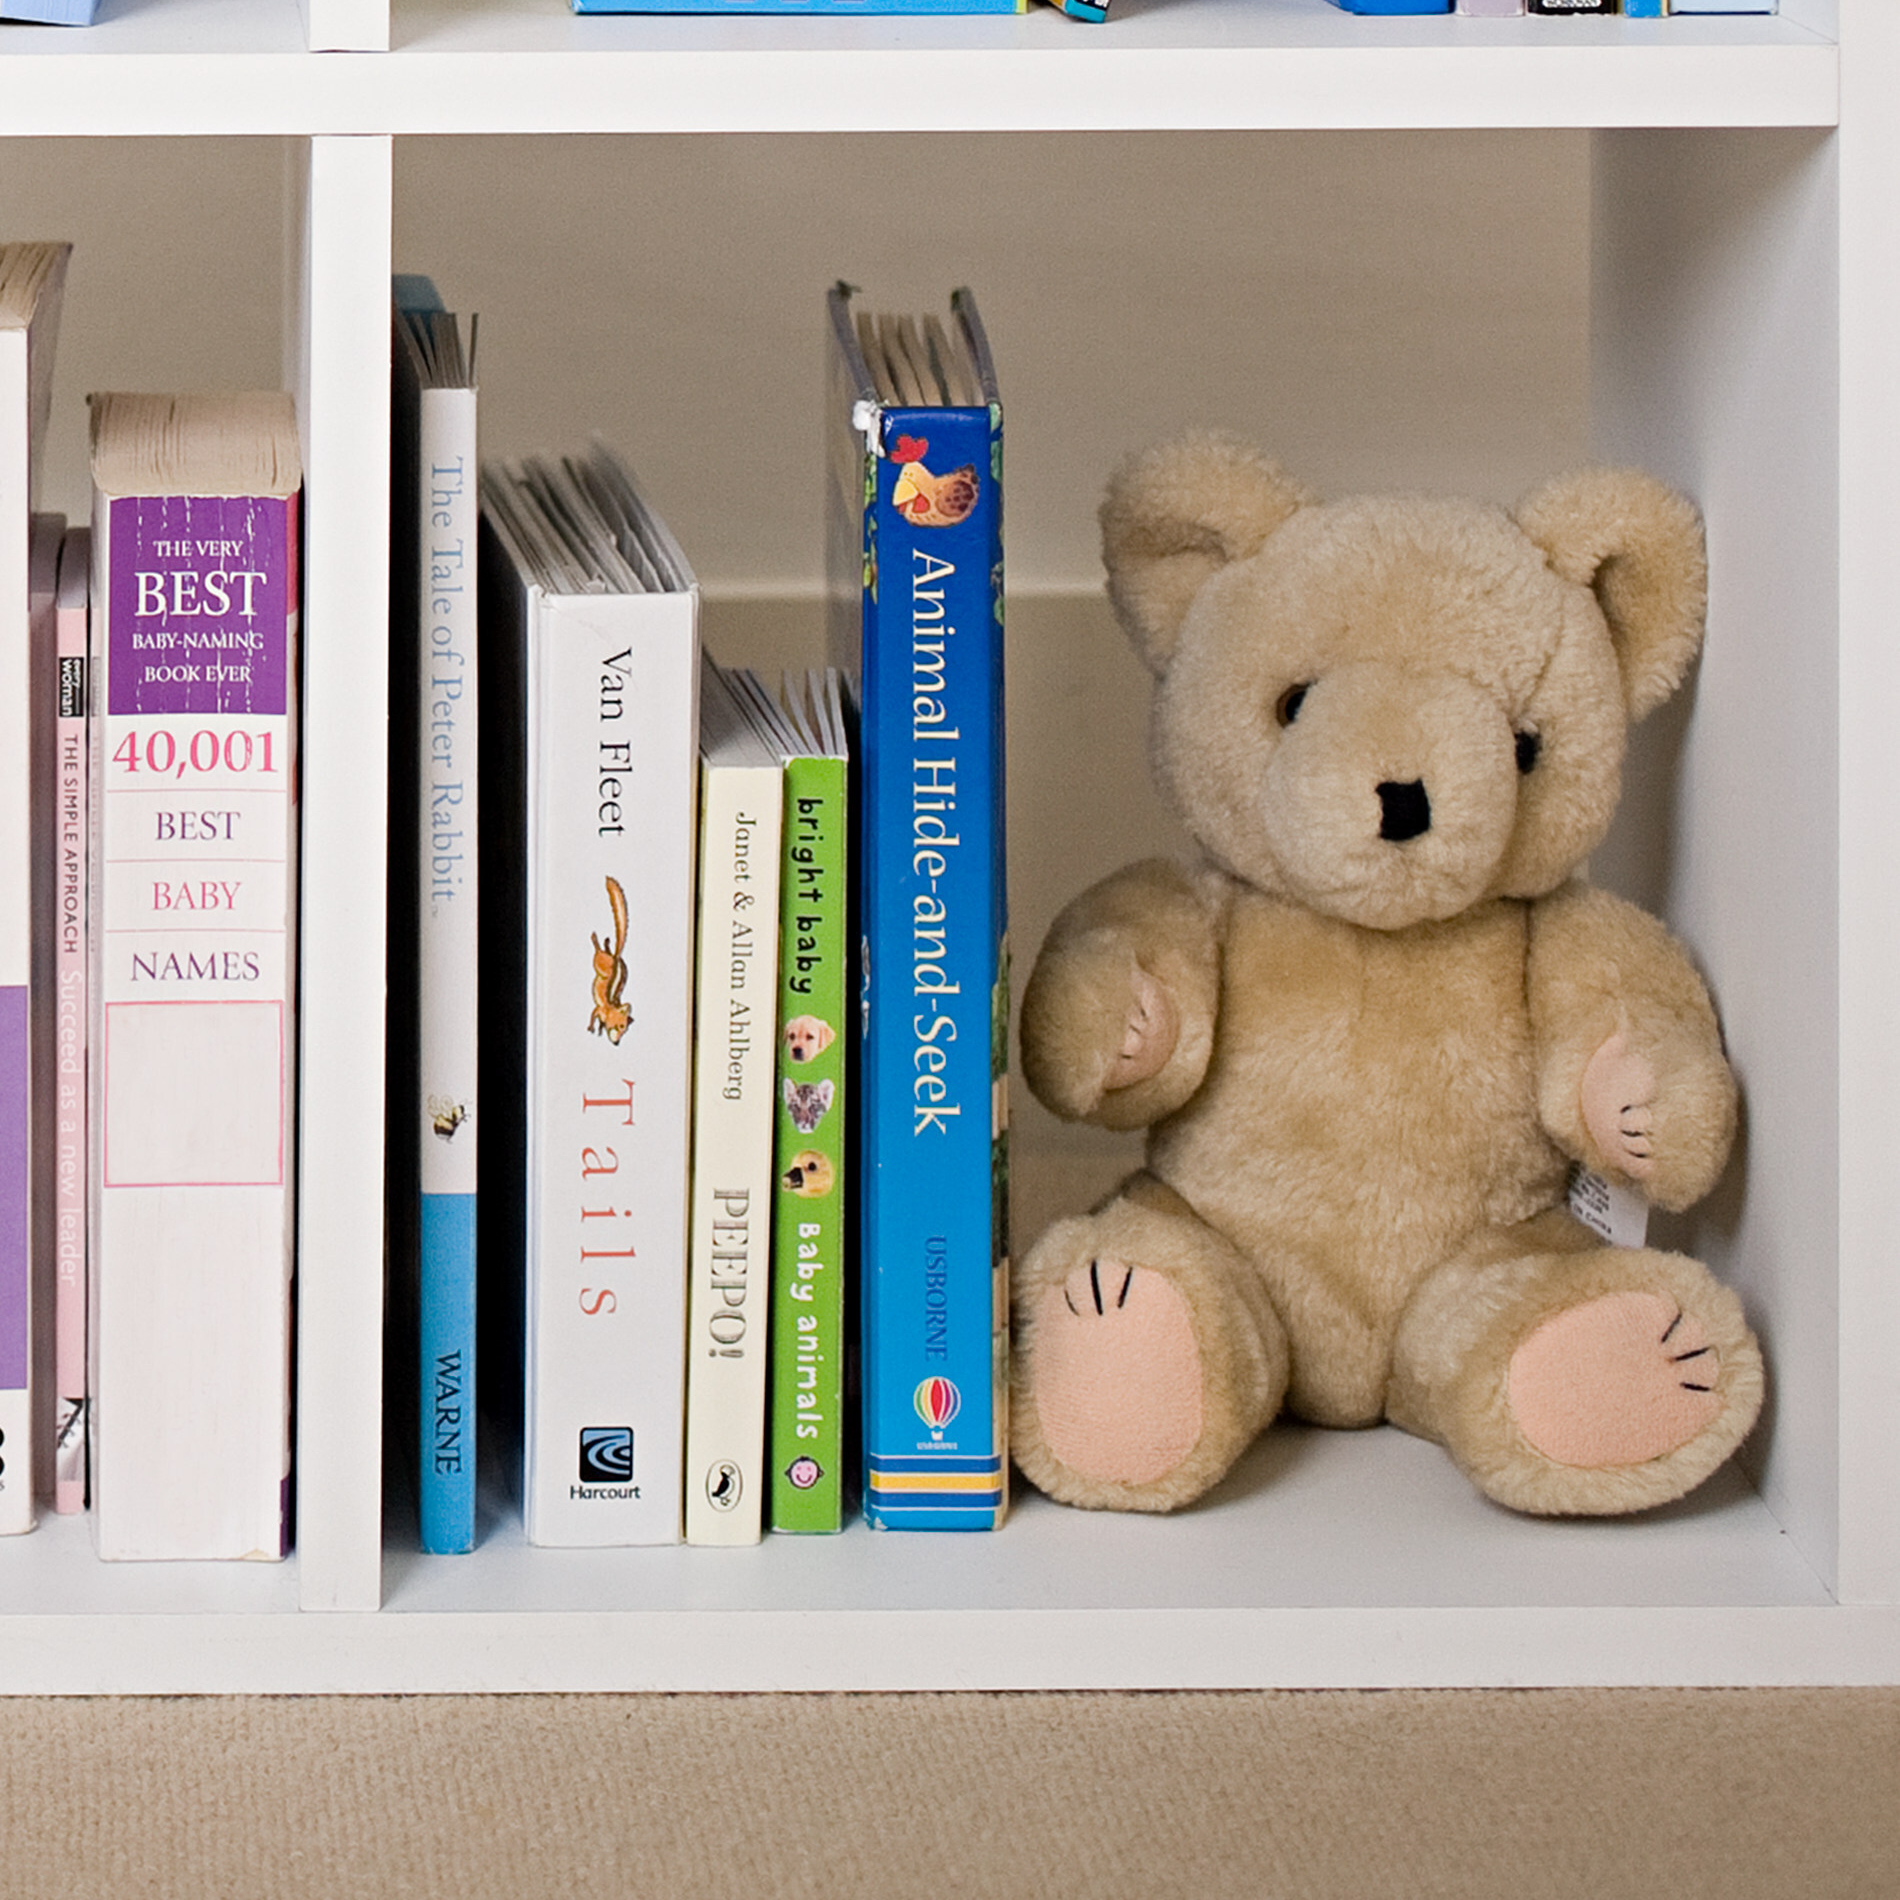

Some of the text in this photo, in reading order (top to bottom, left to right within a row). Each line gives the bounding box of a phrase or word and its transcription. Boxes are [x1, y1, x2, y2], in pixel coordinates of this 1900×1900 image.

[134, 569, 268, 617] BEST
[153, 539, 245, 558] THE VERY
[132, 631, 265, 651] BABY-NAMING
[144, 664, 253, 684] BOOK EVER
[430, 455, 465, 903] The Tale of Peter Rabbit
[112, 729, 279, 780] 40,001
[597, 646, 633, 838] Van Fleet
[62, 733, 80, 955] THE SIMPLE APPROACH
[155, 810, 242, 842] BEST
[911, 548, 962, 1138] Animal Hide-and-Seek
[151, 880, 243, 911] BABY
[722, 811, 758, 1102] Janet & Allan Ahlberg
[789, 797, 825, 994] bright baby
[130, 951, 260, 983] NAMES
[708, 1187, 750, 1359] PEEPO!
[791, 1221, 824, 1440] Baby animals
[924, 1233, 948, 1362] USBORNE
[433, 1348, 463, 1477] WARNE
[569, 1484, 641, 1501] Harcourt
